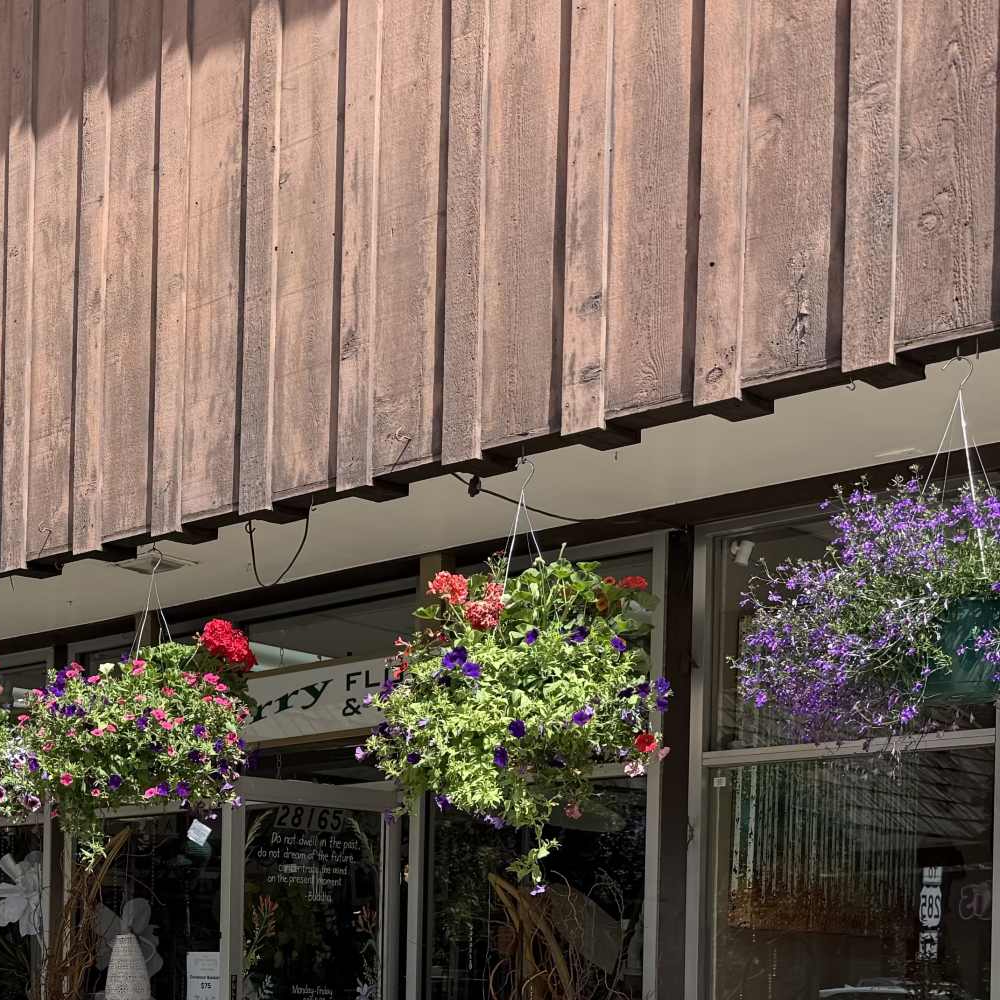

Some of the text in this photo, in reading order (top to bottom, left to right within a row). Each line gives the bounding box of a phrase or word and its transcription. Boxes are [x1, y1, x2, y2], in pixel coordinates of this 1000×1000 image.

[250, 678, 334, 725] rry
[342, 697, 362, 717] &
[277, 806, 344, 830] 28165
[271, 832, 281, 844] Do
[284, 834, 296, 845] not
[299, 835, 318, 847] dwell
[329, 836, 342, 849] the
[257, 848, 267, 857] do
[269, 848, 281, 858] not
[284, 847, 306, 859] dream
[318, 850, 329, 862] the
[201, 982, 212, 990] $75
